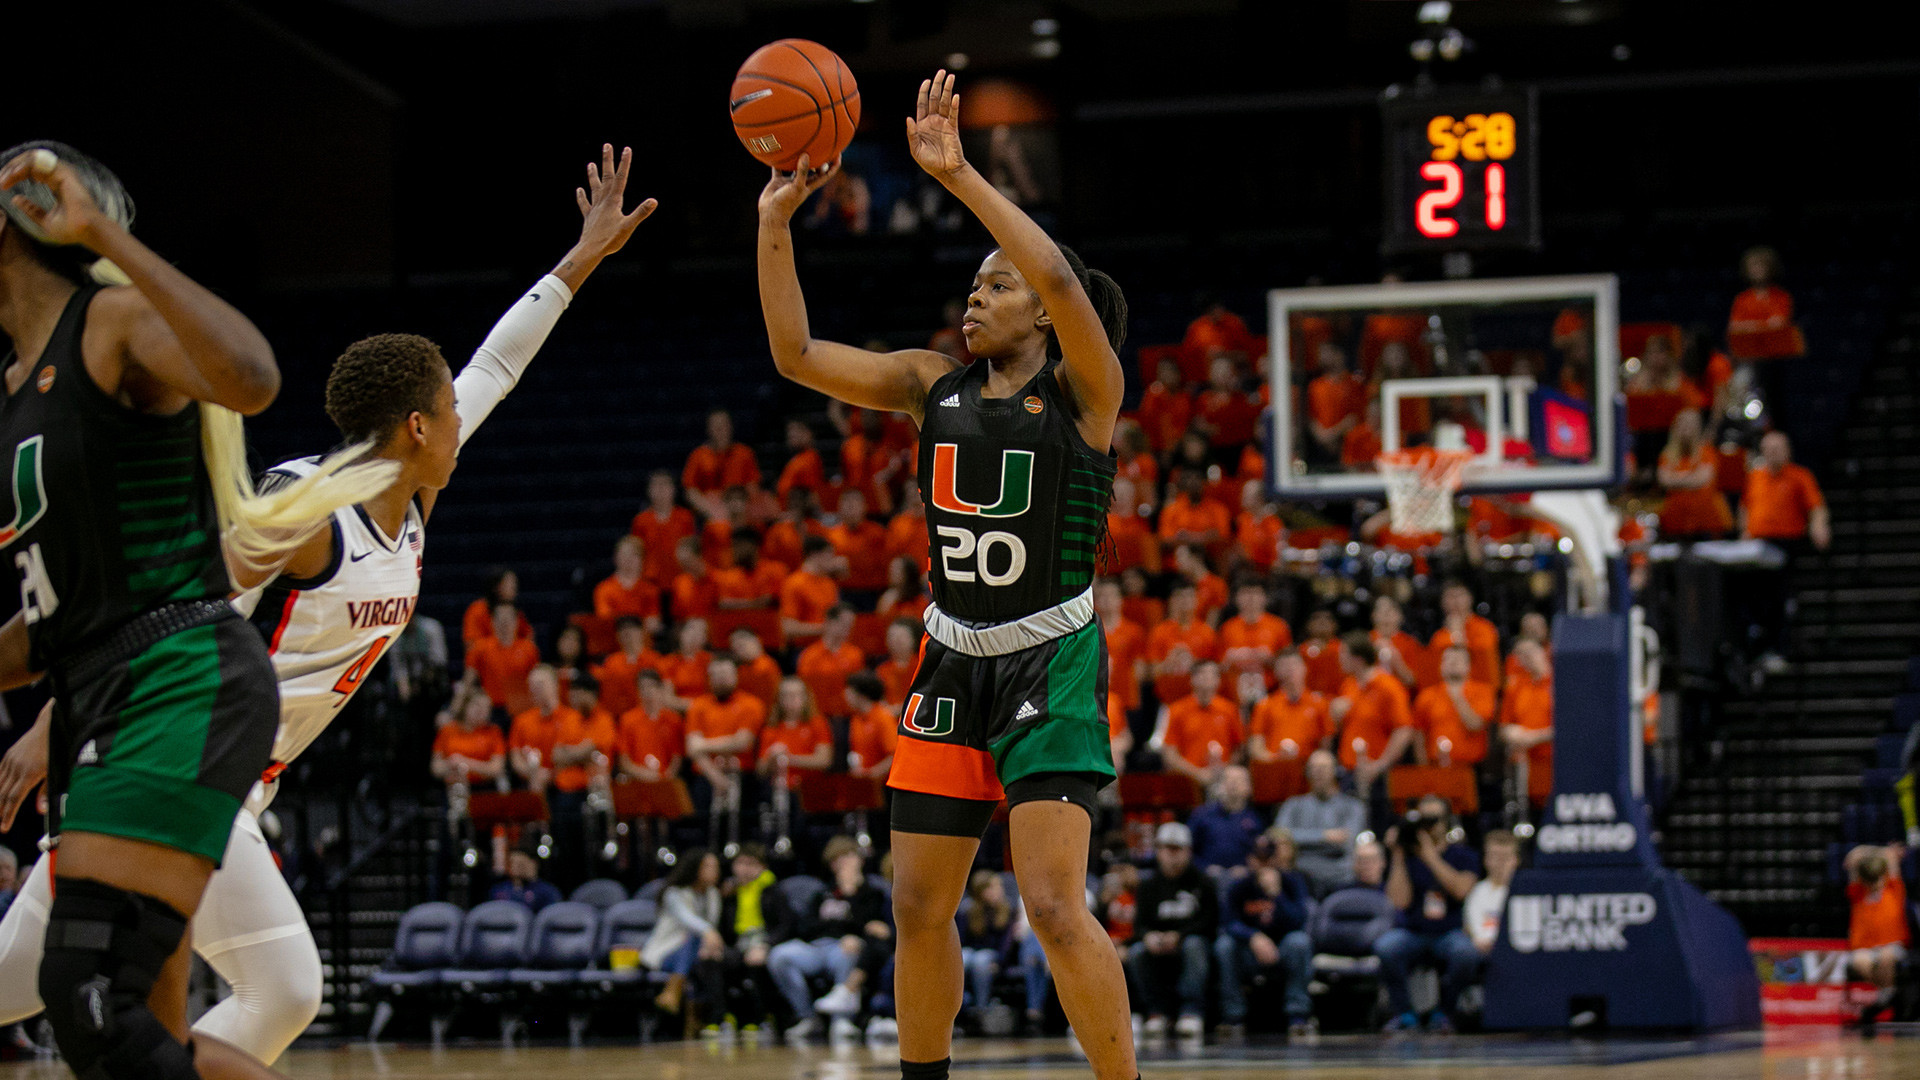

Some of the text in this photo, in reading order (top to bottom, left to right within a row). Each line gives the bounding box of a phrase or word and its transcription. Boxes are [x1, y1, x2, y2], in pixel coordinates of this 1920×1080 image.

[1415, 161, 1505, 238] 21
[932, 443, 1035, 518] U
[937, 525, 1026, 586] 20
[903, 693, 955, 736] U
[1555, 793, 1616, 822] UVA
[1542, 893, 1656, 924] UNITED
[1542, 922, 1628, 951] BANK
